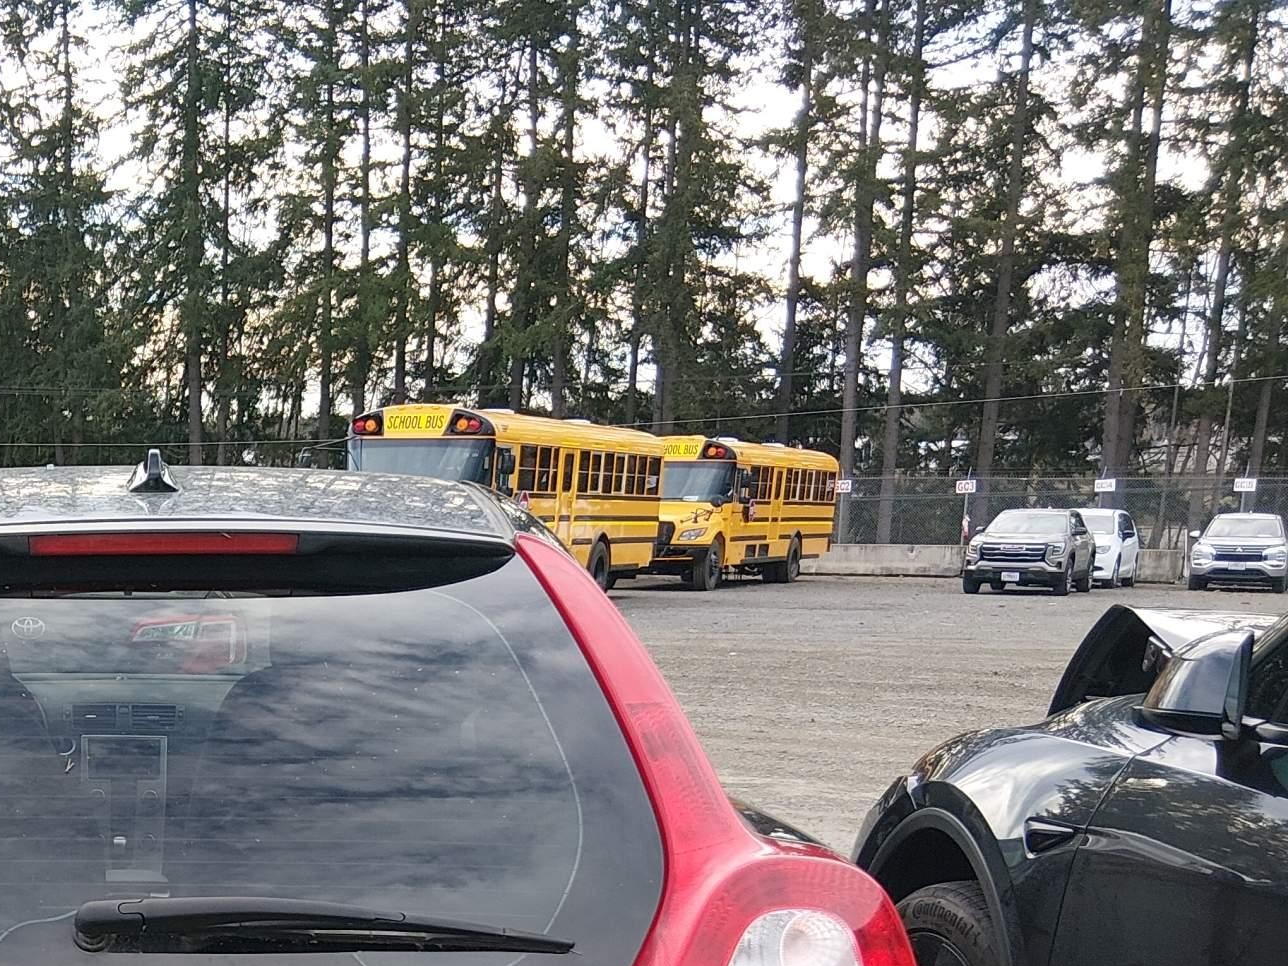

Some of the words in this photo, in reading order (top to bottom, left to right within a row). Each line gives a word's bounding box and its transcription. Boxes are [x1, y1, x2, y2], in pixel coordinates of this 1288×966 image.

[386, 415, 423, 430] SCHOOL
[424, 415, 445, 430] BUS
[683, 444, 699, 455] BUS
[912, 899, 975, 938] Continental
